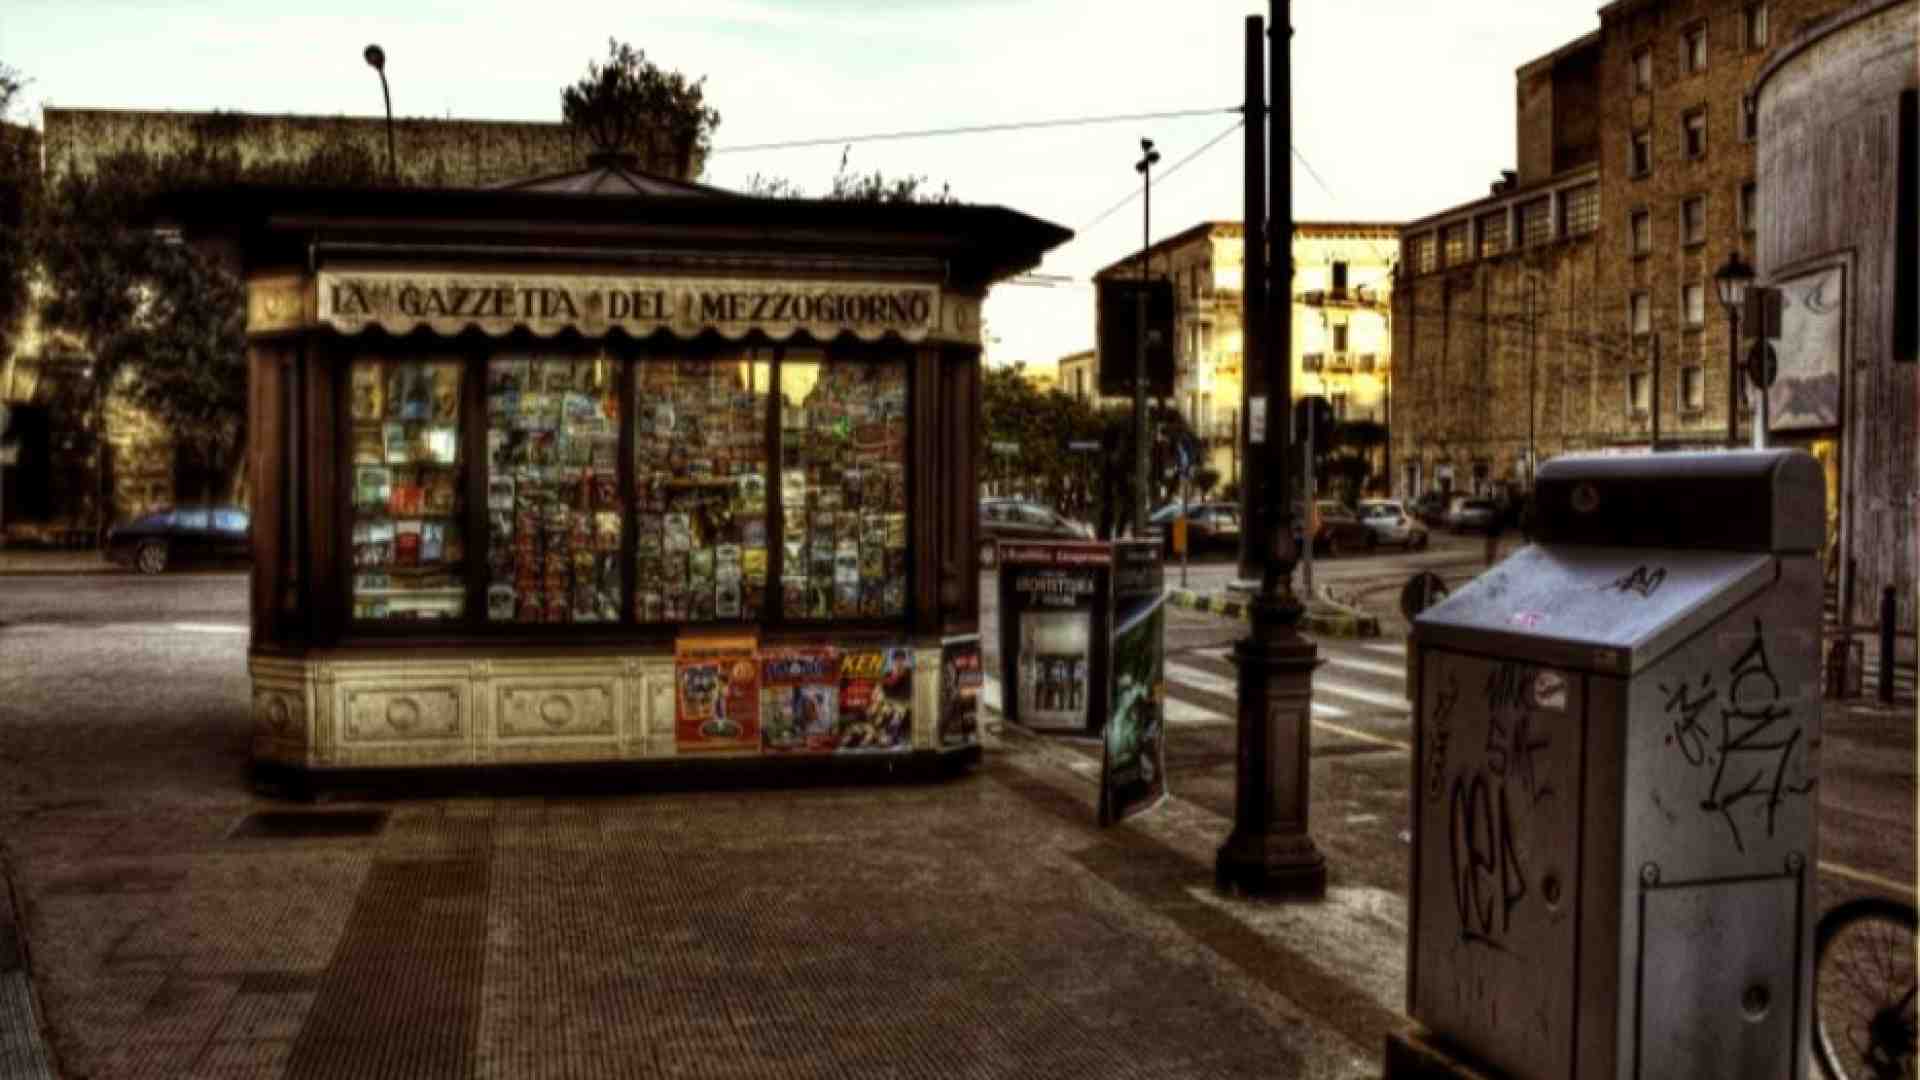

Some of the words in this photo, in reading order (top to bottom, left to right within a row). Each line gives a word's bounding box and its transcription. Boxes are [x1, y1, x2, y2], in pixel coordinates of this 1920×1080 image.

[331, 284, 369, 314] LA
[399, 285, 578, 317] GAZZETTA
[608, 289, 672, 319] DEL
[700, 292, 929, 322] MEZZOGIORNO
